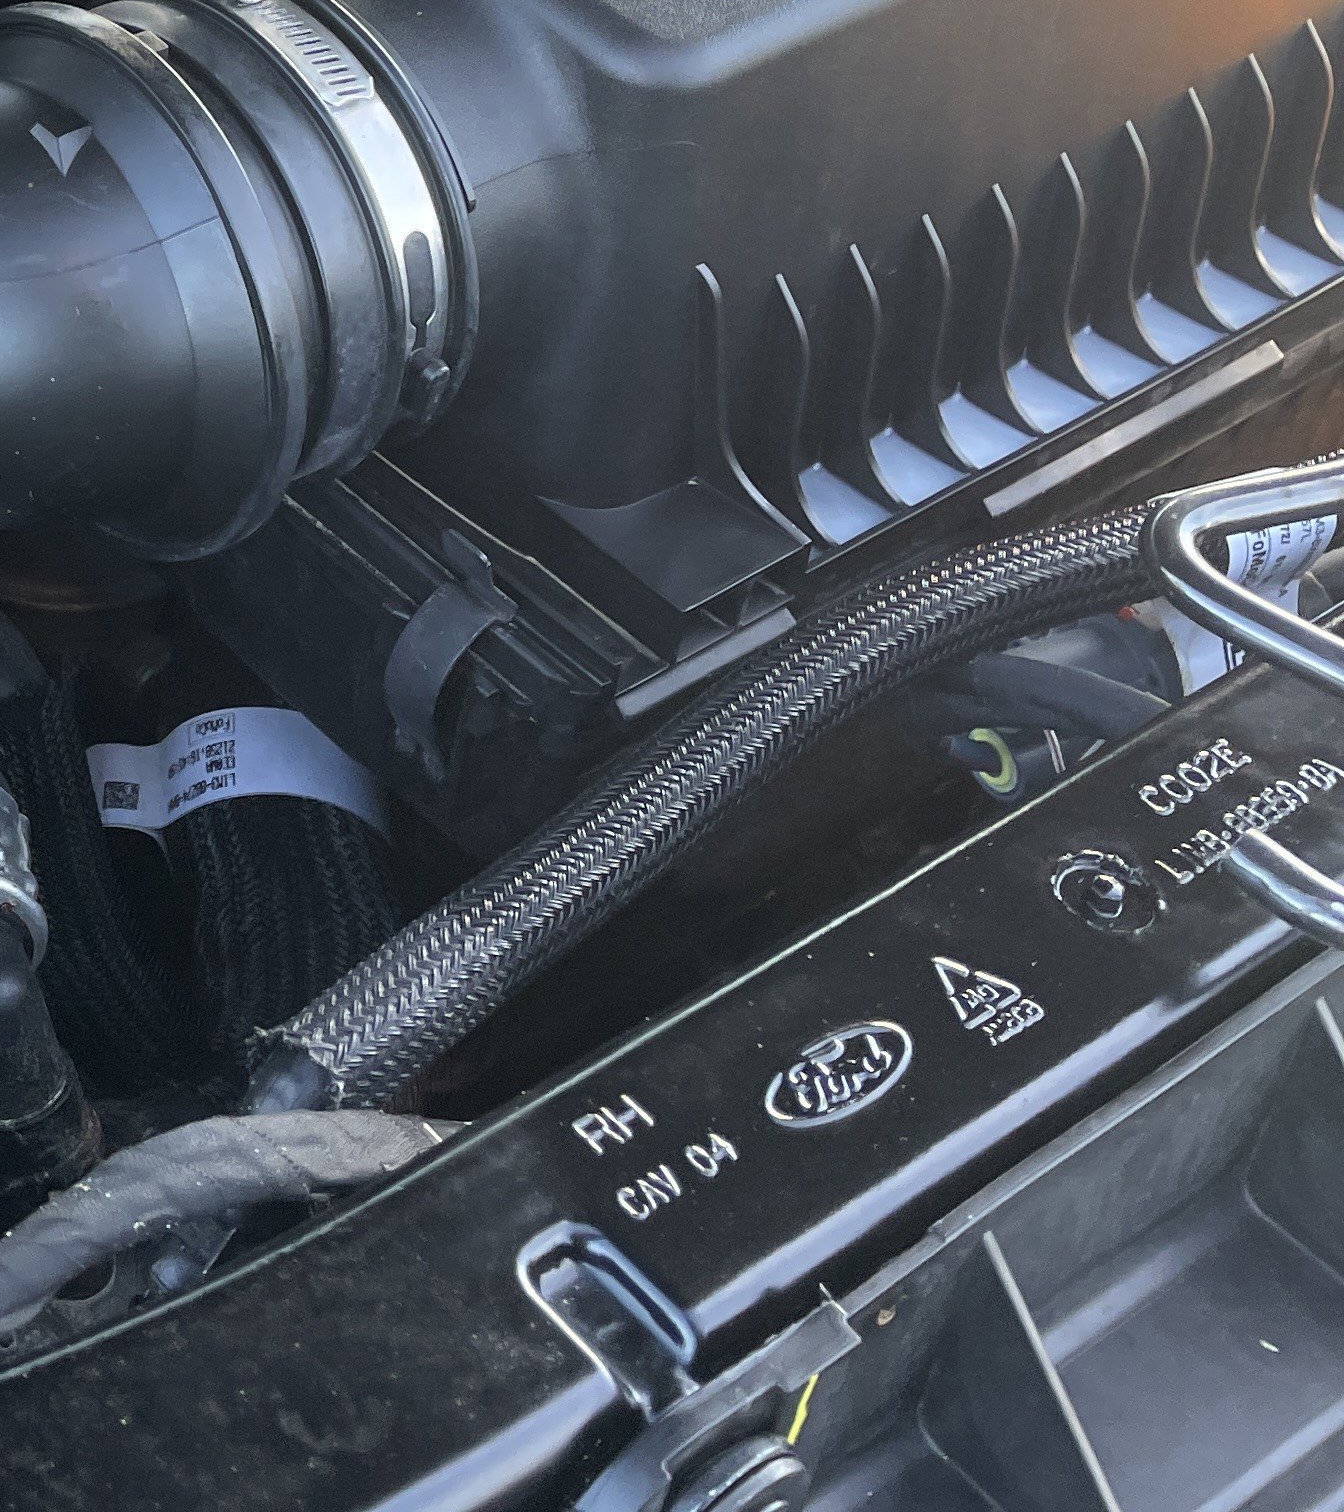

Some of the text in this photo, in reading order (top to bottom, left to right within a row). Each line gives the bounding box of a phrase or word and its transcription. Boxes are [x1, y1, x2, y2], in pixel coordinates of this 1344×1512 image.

[572, 1094, 654, 1156] RH
[616, 1132, 739, 1220] CAV 04
